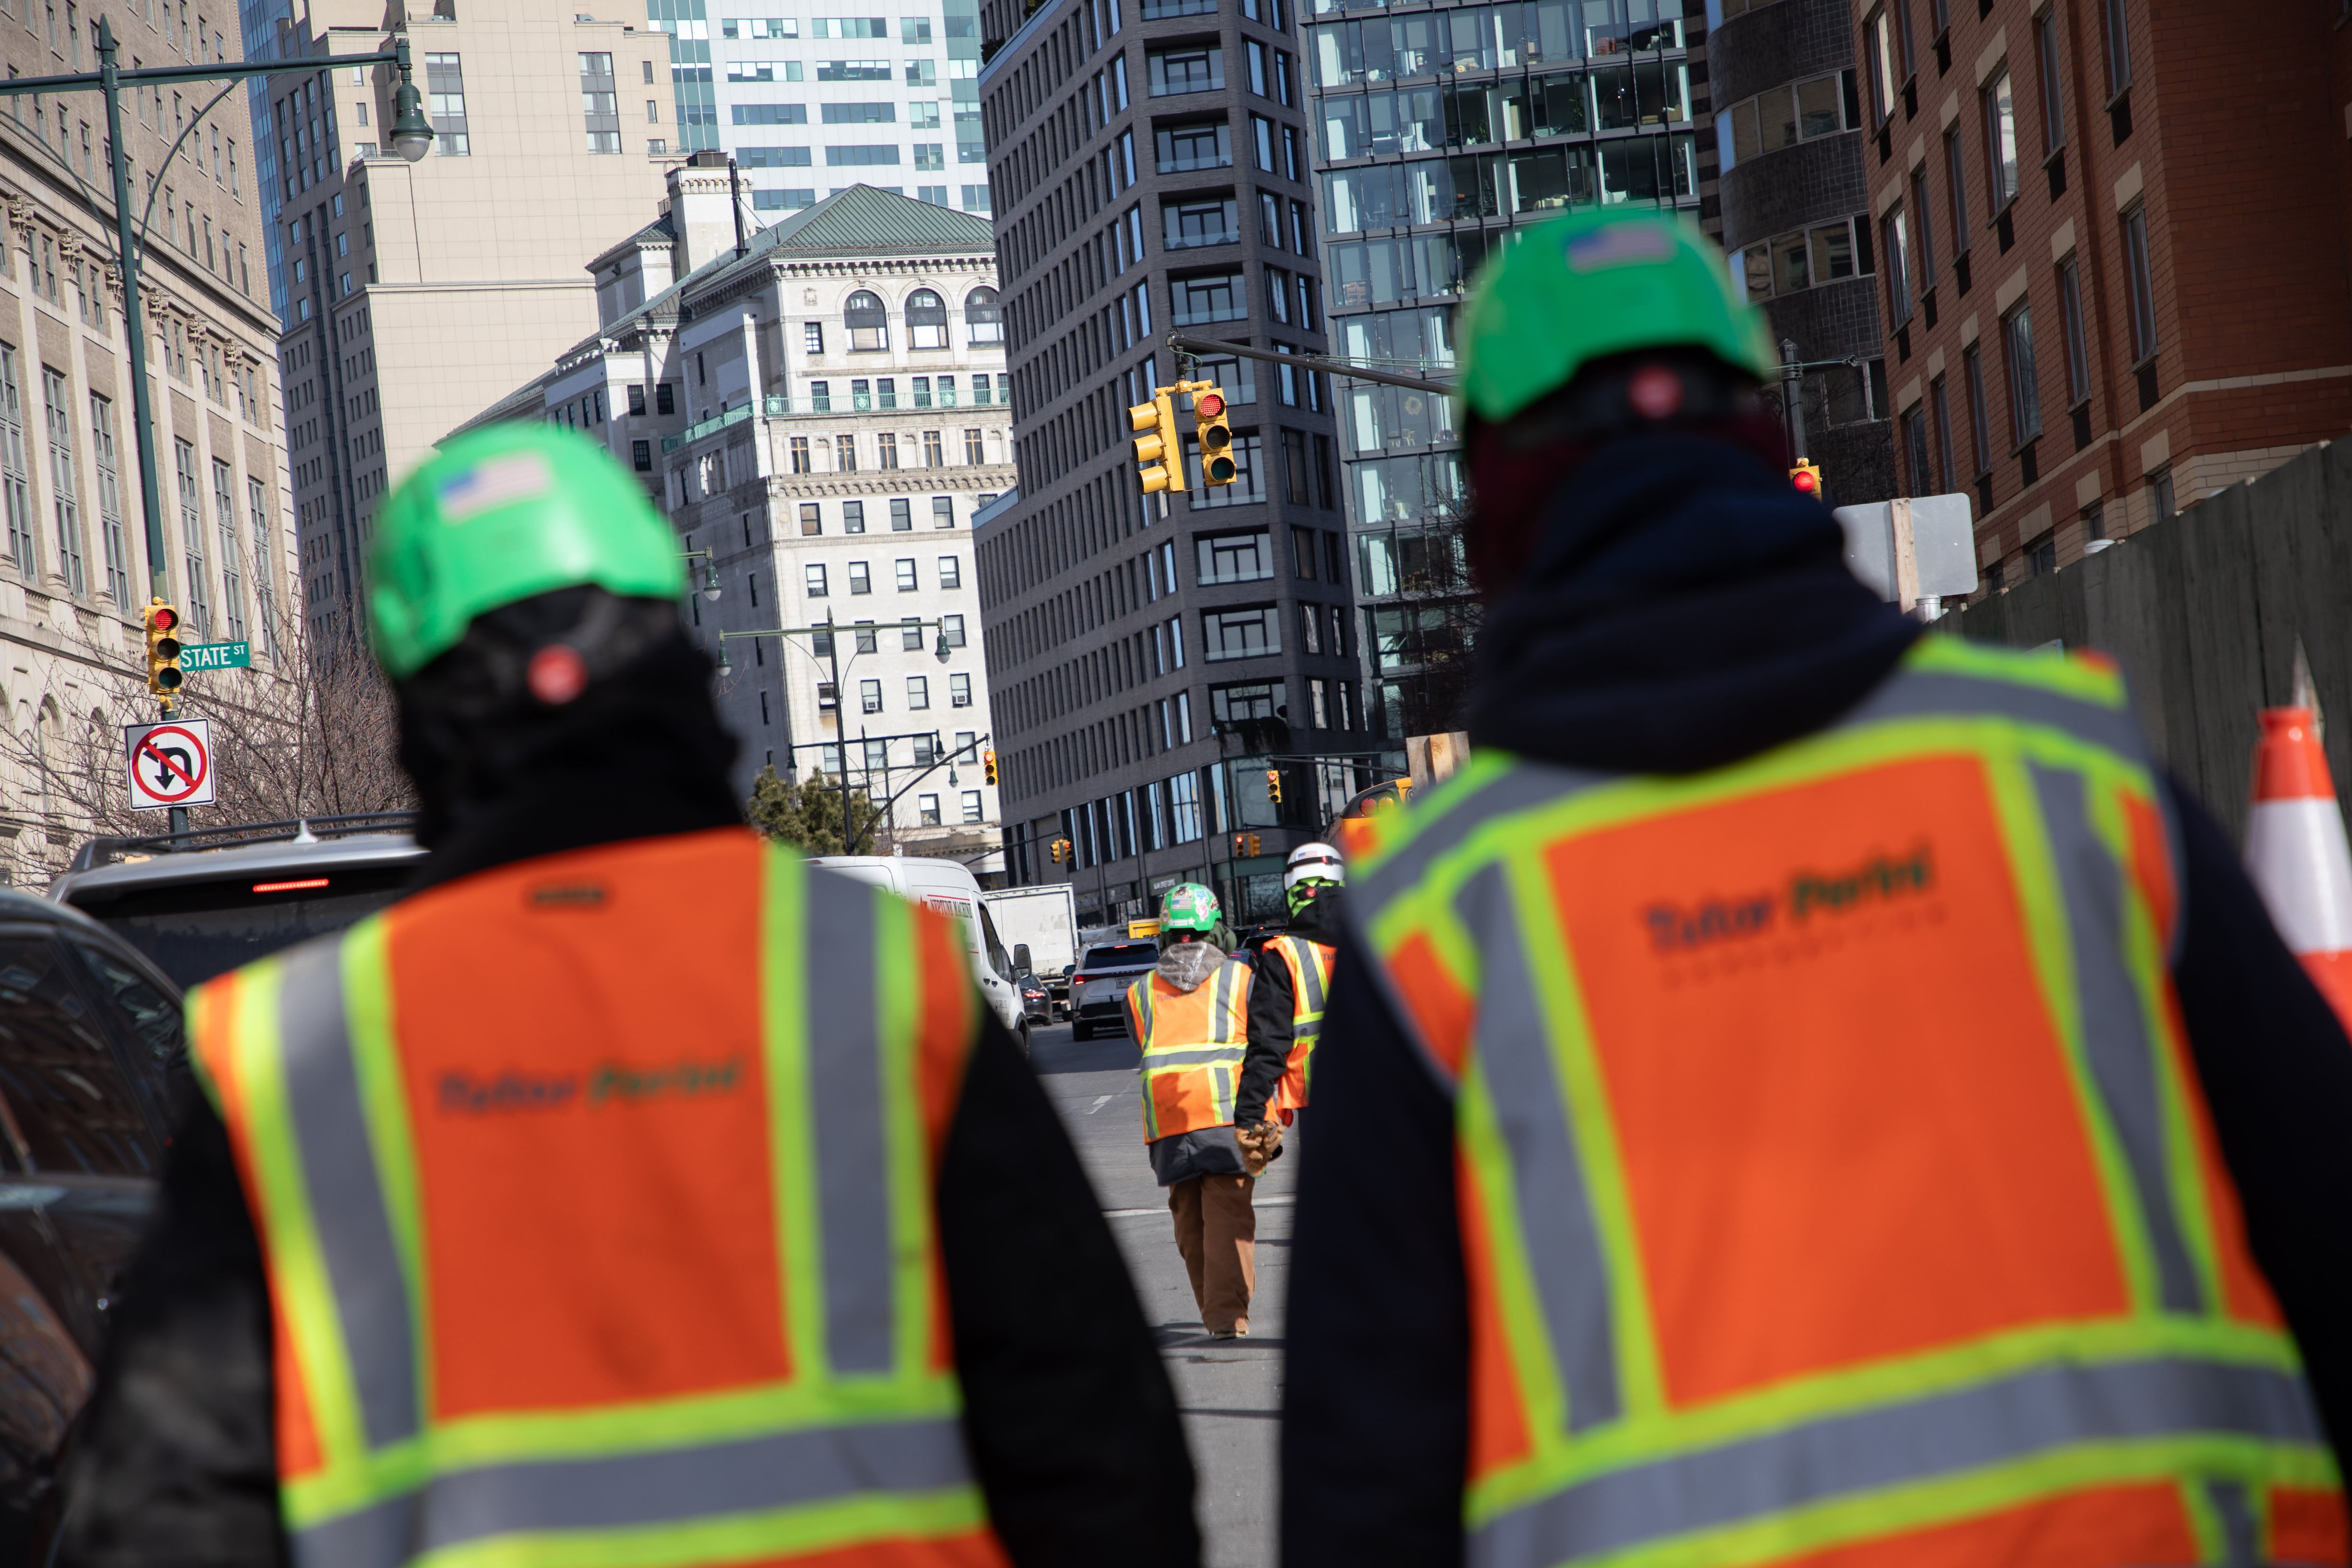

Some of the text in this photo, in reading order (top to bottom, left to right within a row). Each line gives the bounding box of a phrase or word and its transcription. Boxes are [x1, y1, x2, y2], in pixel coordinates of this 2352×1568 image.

[181, 645, 245, 668] STATE ST
[930, 899, 973, 919] NEPTUNE MACHINE
